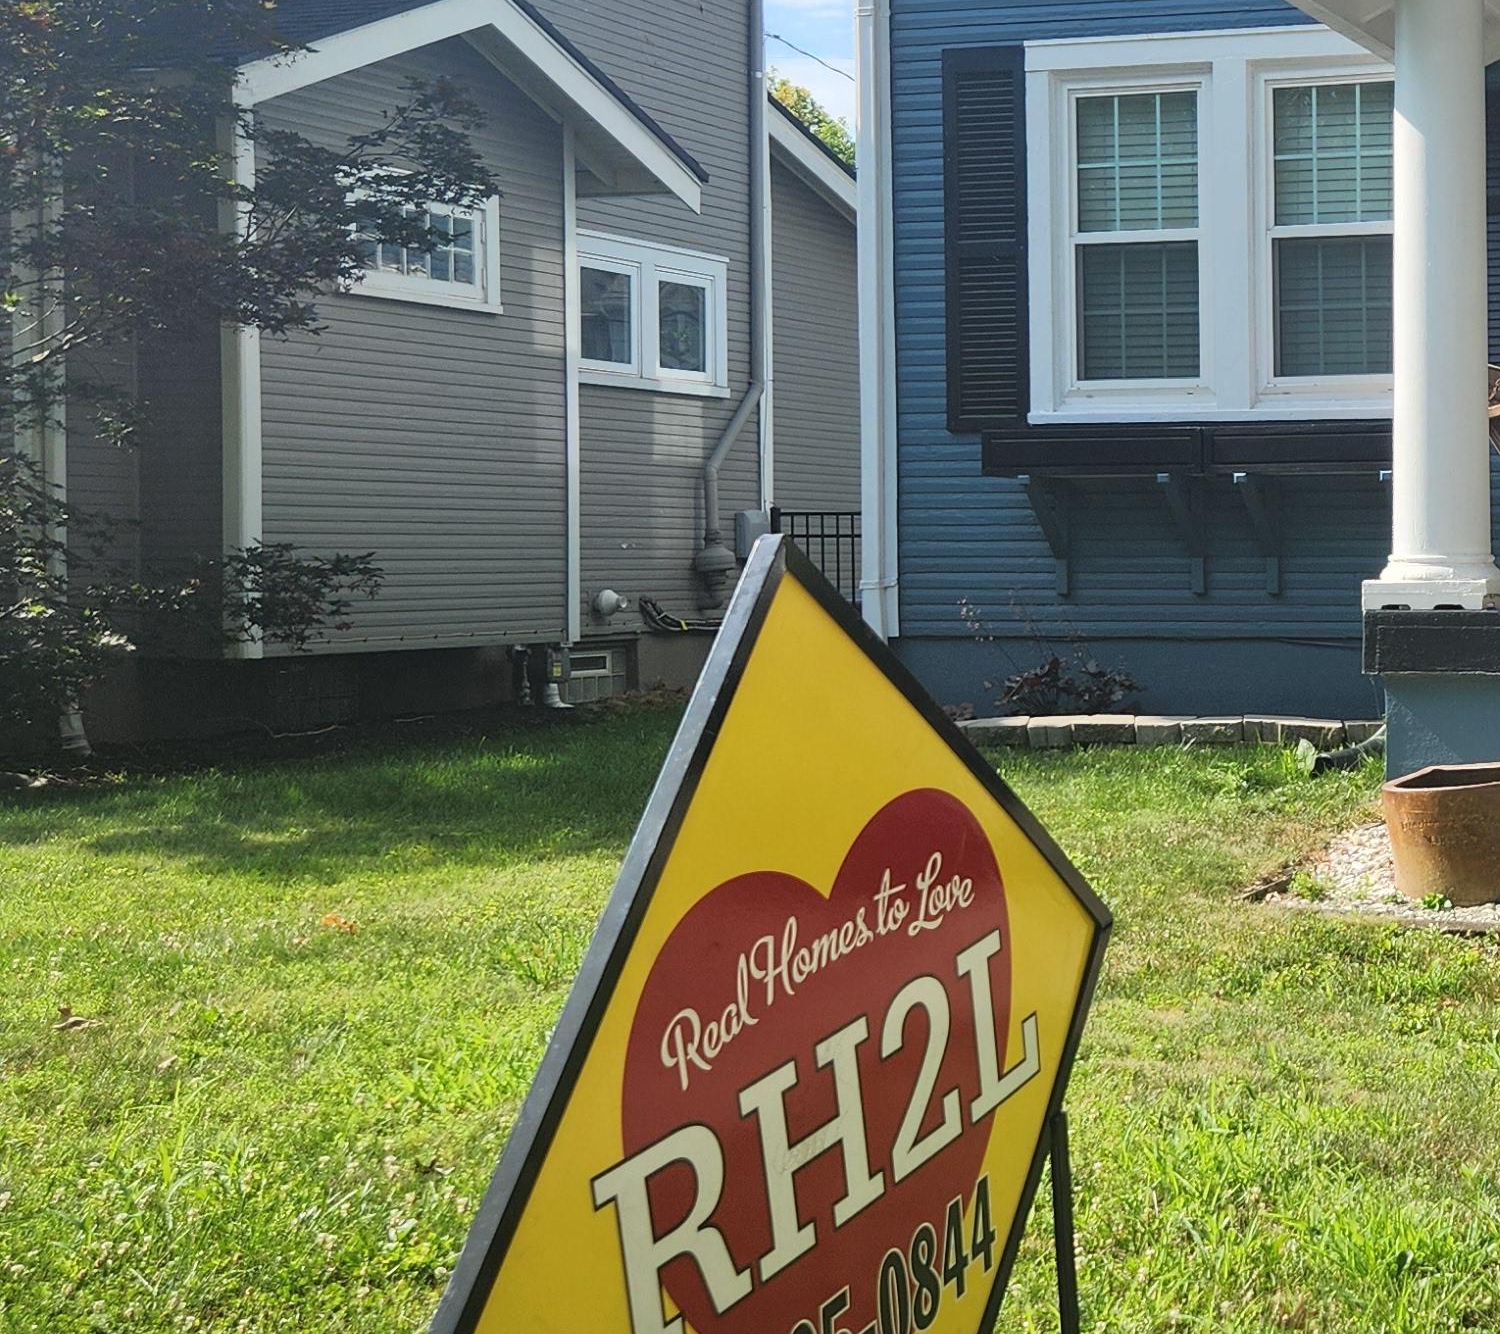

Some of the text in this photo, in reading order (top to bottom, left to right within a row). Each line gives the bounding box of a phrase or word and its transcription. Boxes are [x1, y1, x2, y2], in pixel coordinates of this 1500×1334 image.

[660, 850, 976, 1091] Real Homes to Love
